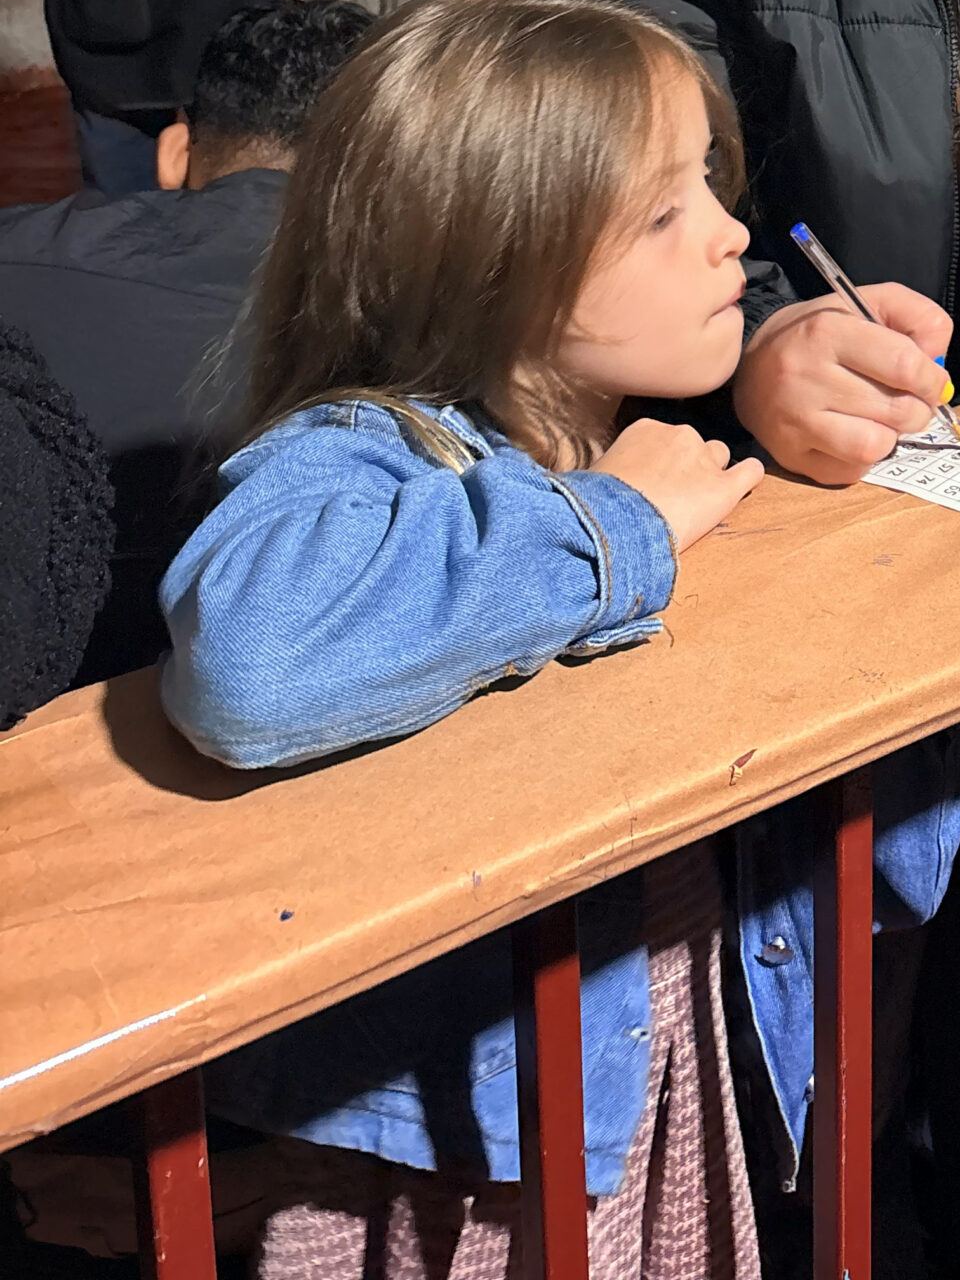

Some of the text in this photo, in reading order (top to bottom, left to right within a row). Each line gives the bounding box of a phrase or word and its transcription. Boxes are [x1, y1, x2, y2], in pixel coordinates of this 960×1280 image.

[886, 467, 908, 477] 72
[937, 463, 955, 473] 57
[915, 475, 936, 485] 74
